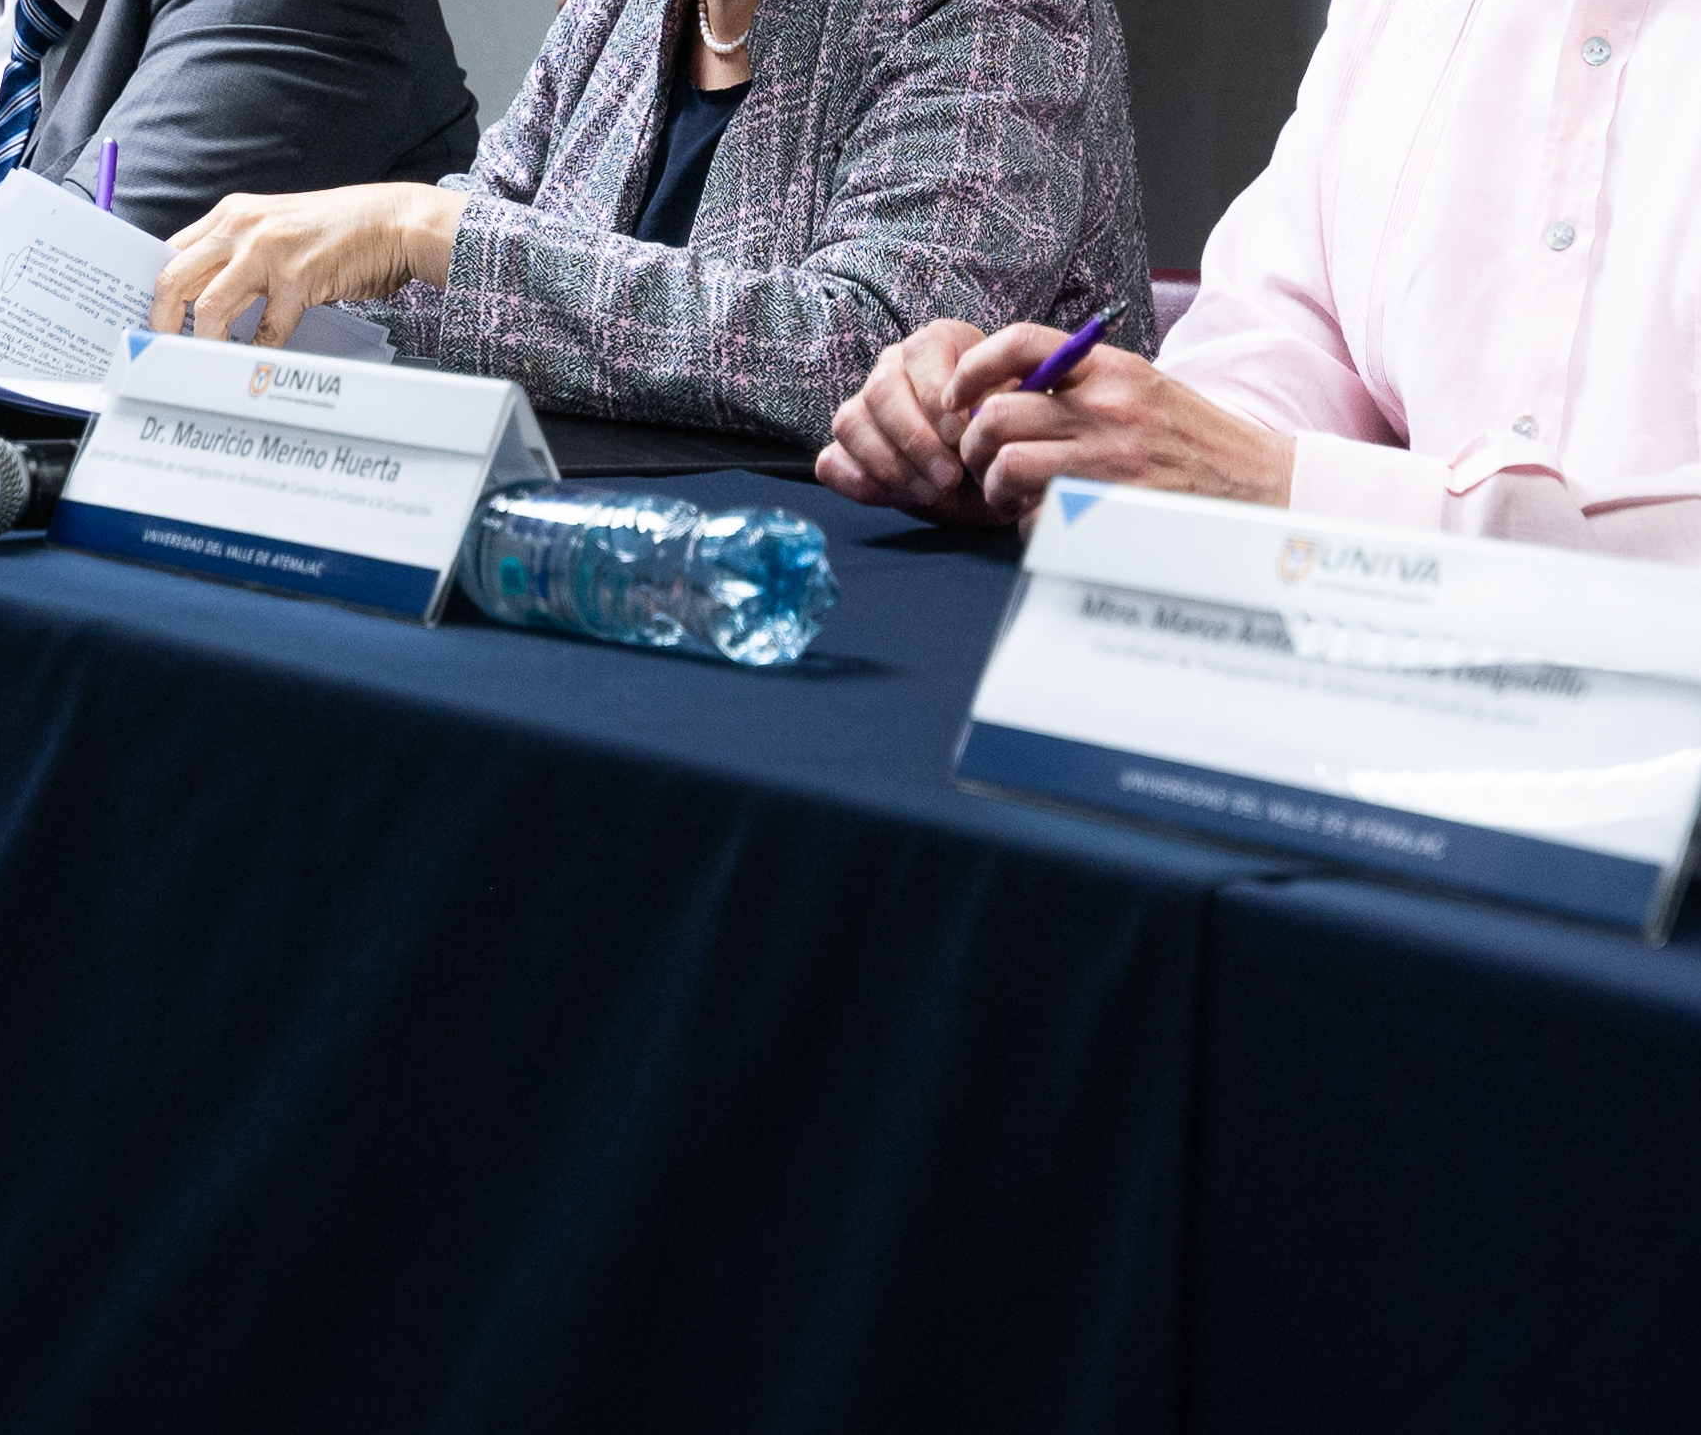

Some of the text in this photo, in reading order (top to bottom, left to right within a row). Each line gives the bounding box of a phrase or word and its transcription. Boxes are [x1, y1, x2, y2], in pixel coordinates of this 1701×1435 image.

[94, 289, 153, 324] esponsabilidades
[272, 367, 342, 397] UNIVA
[140, 415, 403, 483] Dr. Mauricio Merino Huerta
[142, 528, 327, 577] UNIVERSIDAD DEL VALLE DE ATEMAJAC
[1320, 544, 1441, 588] UNIVA
